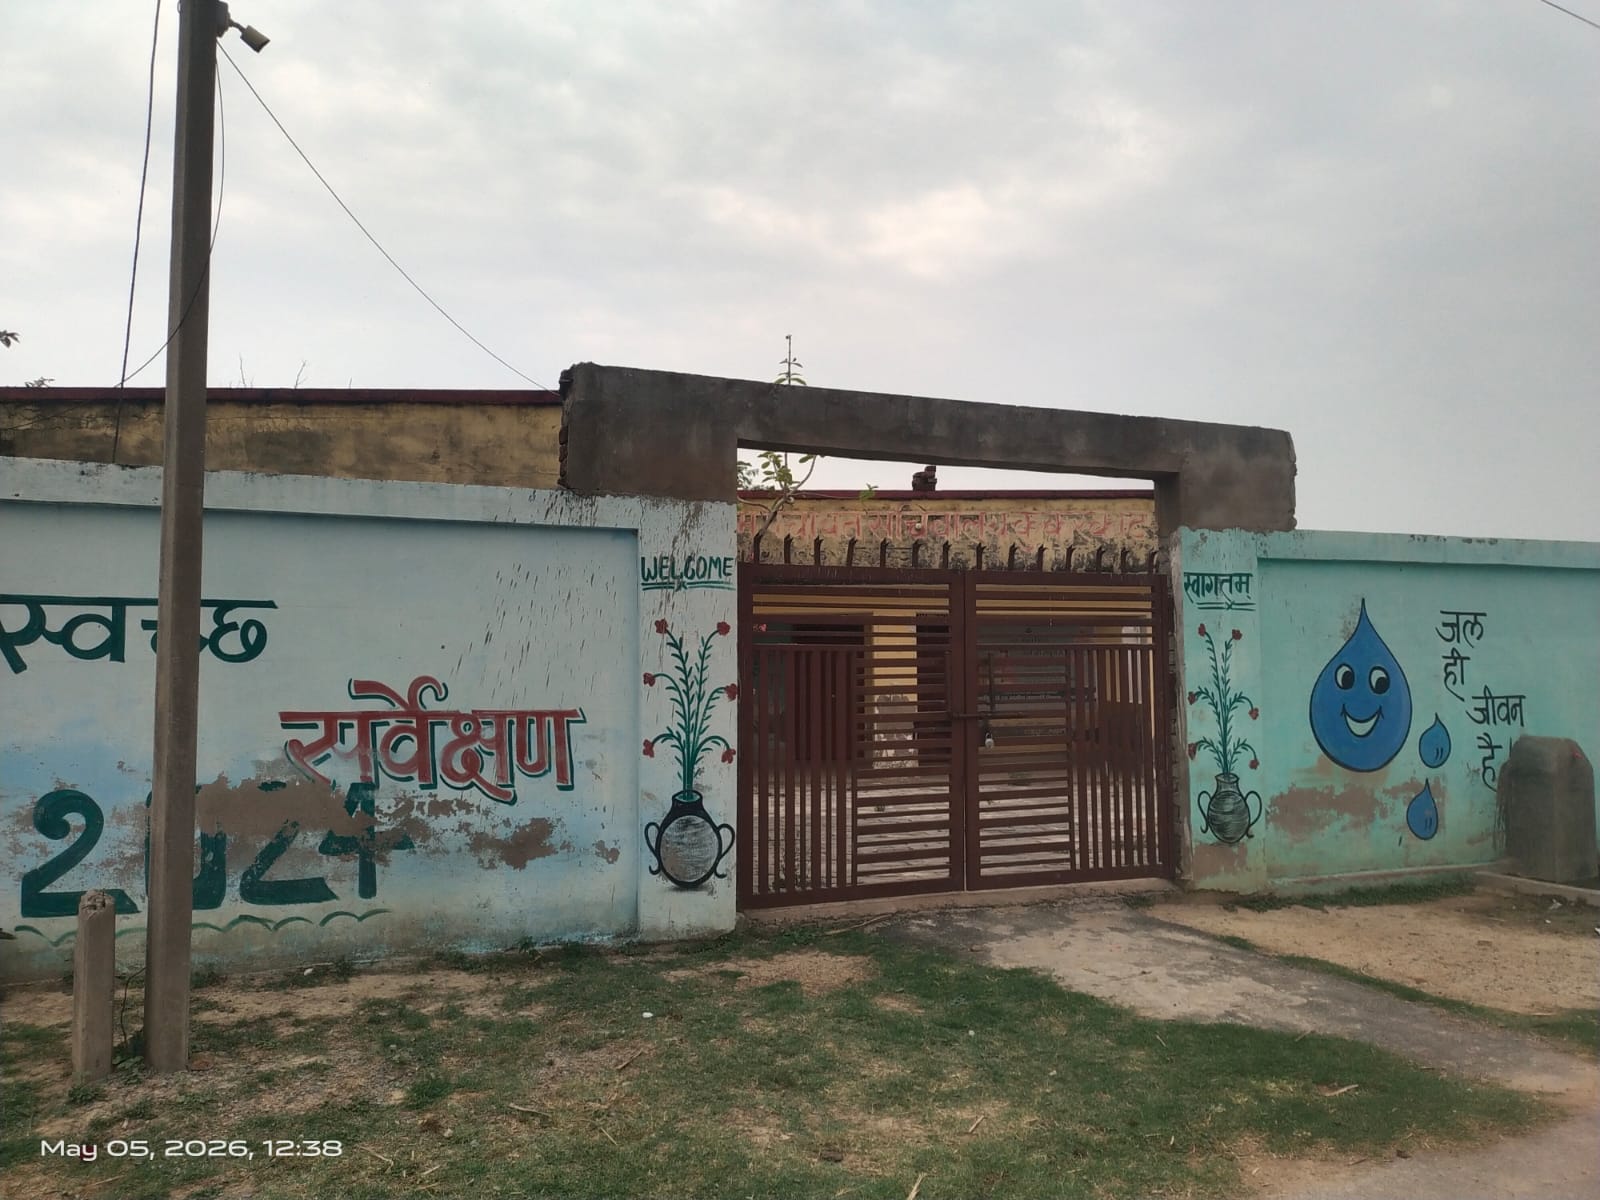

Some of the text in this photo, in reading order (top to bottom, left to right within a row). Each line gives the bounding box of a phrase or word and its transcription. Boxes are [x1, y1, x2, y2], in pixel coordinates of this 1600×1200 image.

[640, 555, 735, 582] WELCOME
[1184, 572, 1254, 604] स्वागतम्
[1436, 610, 1487, 648] जल
[1442, 648, 1471, 702] ही
[1465, 685, 1526, 728] जीवन
[279, 675, 587, 806] सर्वेक्षण
